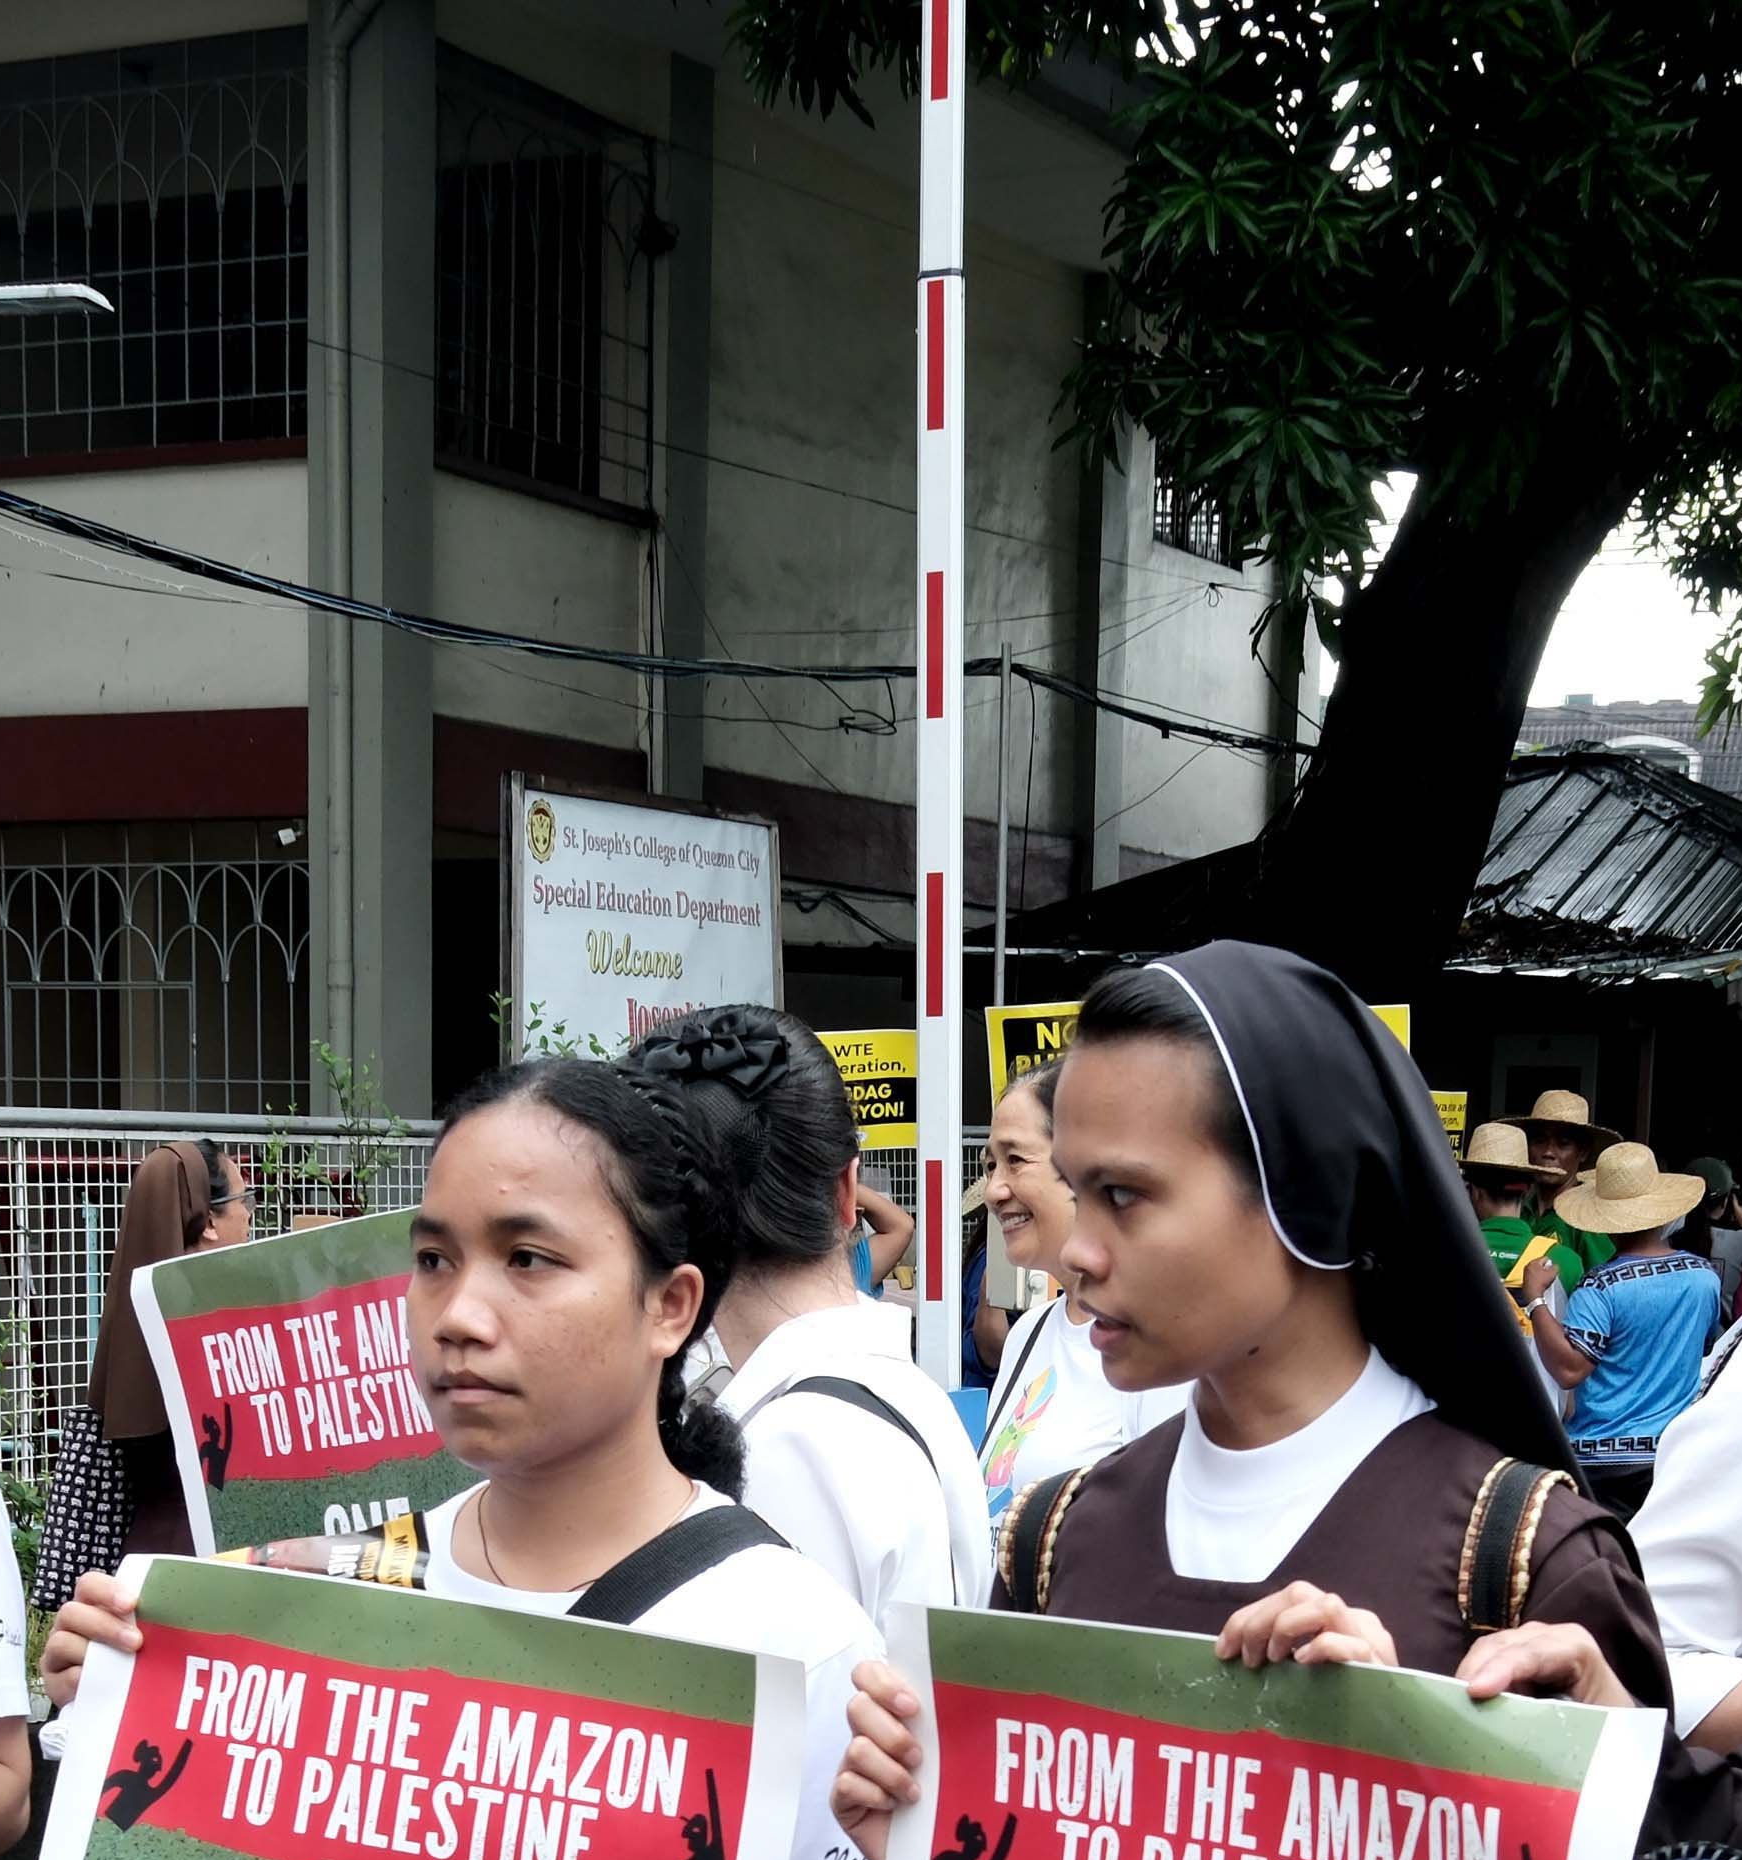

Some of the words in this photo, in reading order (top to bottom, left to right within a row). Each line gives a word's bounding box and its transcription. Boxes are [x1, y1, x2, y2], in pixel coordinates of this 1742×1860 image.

[563, 826, 579, 849] St.
[582, 828, 631, 860] Joseph's
[633, 835, 676, 867] College
[679, 842, 693, 862] of
[692, 844, 735, 869] Quezon
[737, 849, 760, 879] City
[533, 874, 592, 914] Special
[595, 881, 672, 918] Education
[675, 890, 761, 929] Department
[586, 929, 683, 980] Welcome
[834, 1043, 874, 1058] WTE
[840, 1058, 907, 1075] eration,
[853, 1100, 905, 1120] YON!
[202, 1326, 286, 1398] FROM
[283, 1308, 348, 1382] THE
[250, 1395, 293, 1457] TO
[297, 1366, 435, 1451] PALESTIN
[175, 1655, 299, 1750] FROM
[325, 1678, 428, 1773] THE
[441, 1699, 689, 1818] AMAZON
[220, 1741, 281, 1829] TO
[995, 1718, 1134, 1827] FROM
[1159, 1744, 1262, 1850] THE
